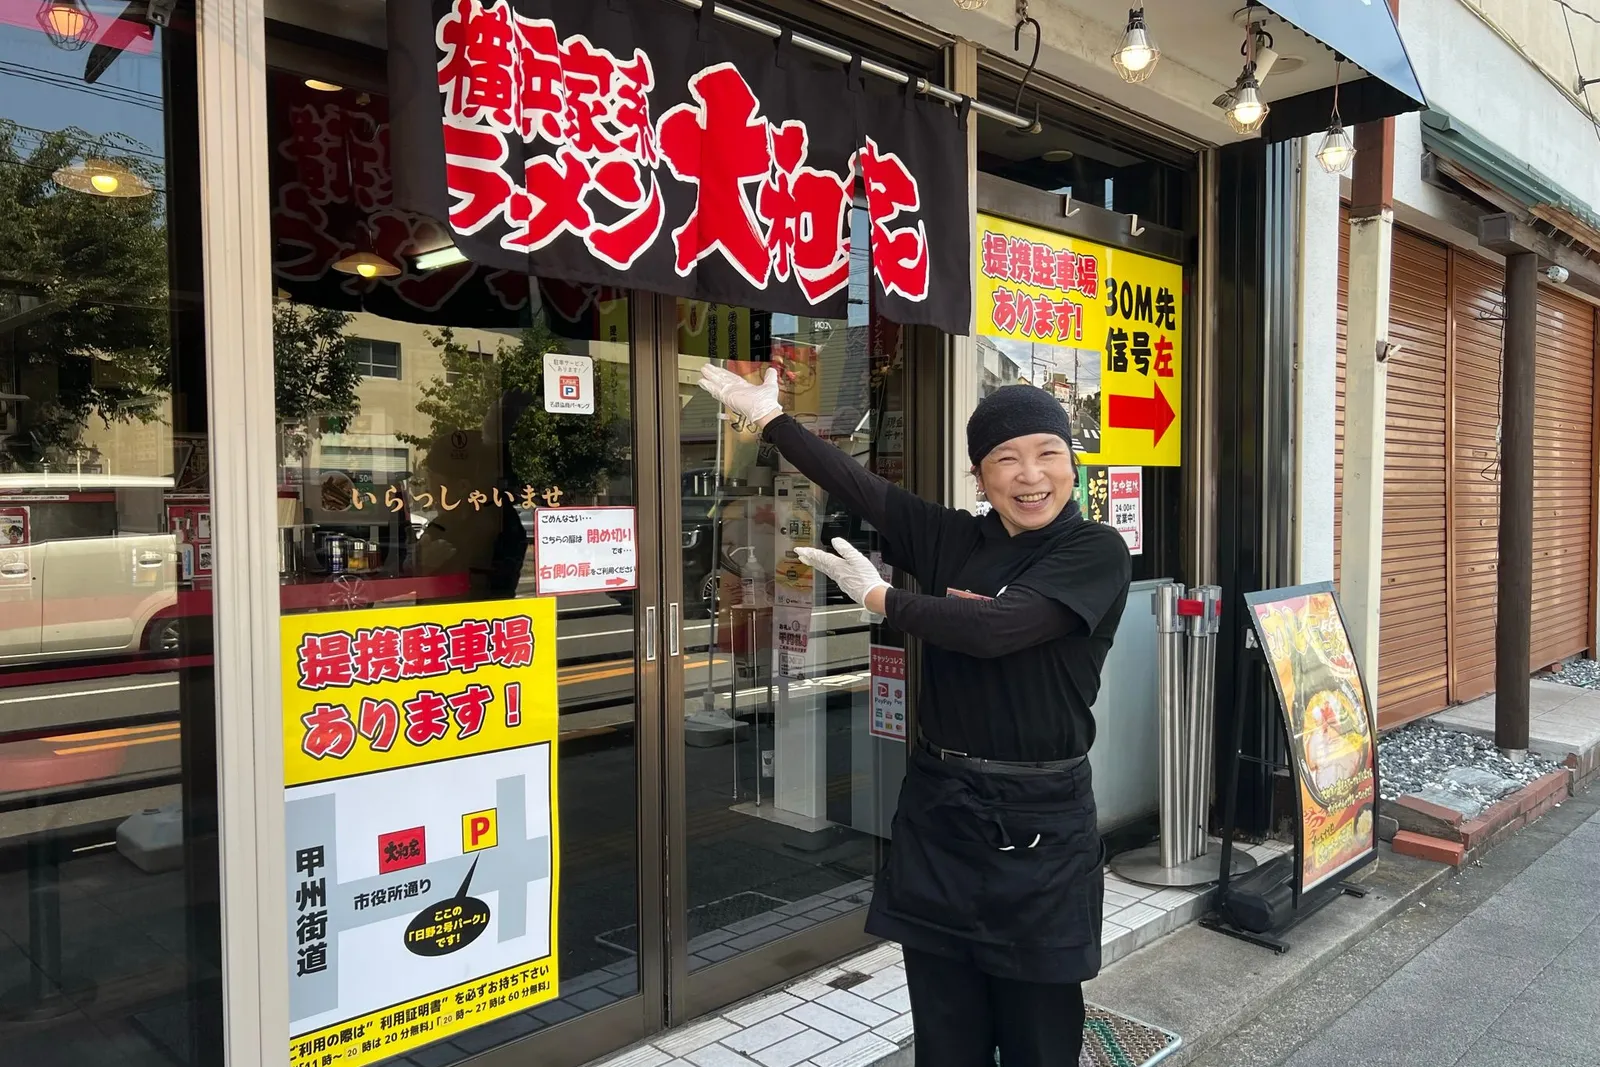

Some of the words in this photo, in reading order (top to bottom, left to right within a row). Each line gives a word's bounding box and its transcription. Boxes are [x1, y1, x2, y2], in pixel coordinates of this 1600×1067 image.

[655, 62, 929, 305] 大和家
[981, 230, 1099, 299] 提携駐車場
[991, 285, 1083, 341] あります!
[1104, 277, 1176, 331] 30M先
[1105, 327, 1175, 377] 信号左
[565, 387, 574, 396] P
[351, 483, 564, 512] いらっしゃいませ
[541, 535, 583, 544] こちらの扉は
[586, 528, 631, 544] 閉め切り
[296, 614, 536, 691] 提携駐車場
[874, 697, 892, 706] PayPay
[300, 681, 521, 759] あります!
[470, 816, 490, 846] P
[296, 845, 327, 977] 甲州街道
[354, 878, 432, 910] 市役所通り
[408, 912, 487, 942] 「日野2号パーク」
[434, 905, 462, 921] ここの
[435, 933, 461, 948] です!
[454, 964, 549, 1005] を必ずお持ち下さい
